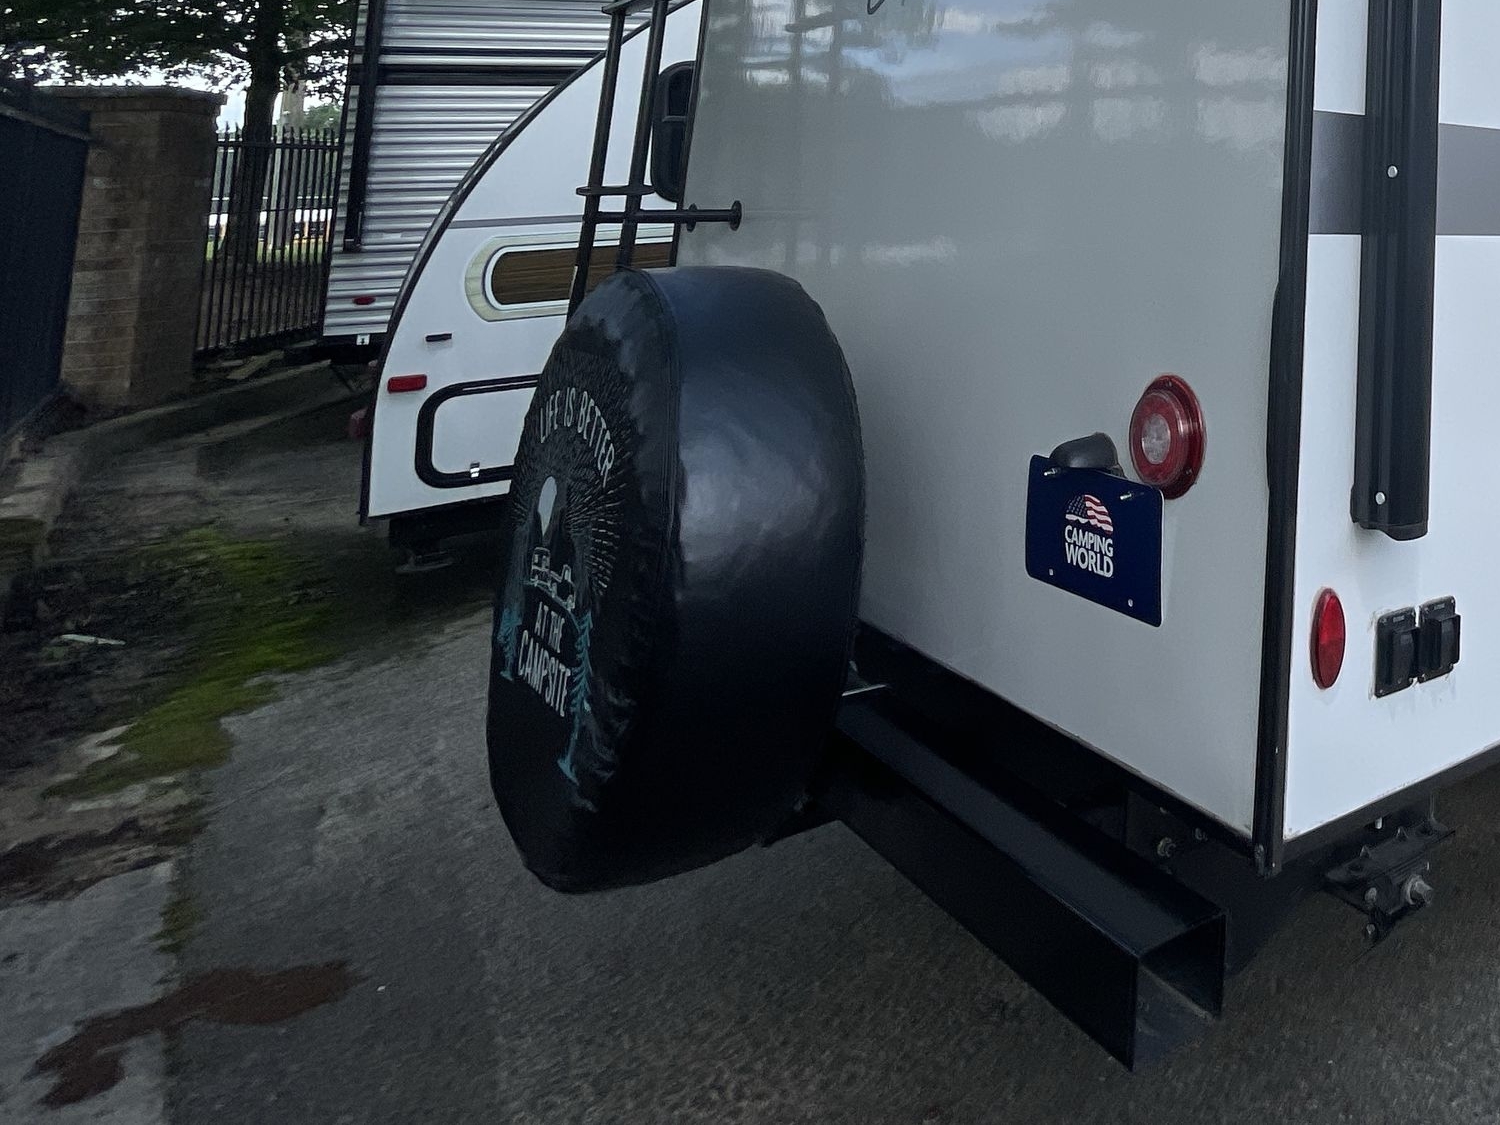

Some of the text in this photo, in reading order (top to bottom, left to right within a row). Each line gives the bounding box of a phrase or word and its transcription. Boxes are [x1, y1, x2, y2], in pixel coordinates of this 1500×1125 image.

[540, 386, 615, 488] LIFE IS BETTER
[1065, 525, 1113, 557] CAMPING
[1065, 542, 1113, 577] WORLD
[534, 601, 566, 653] AT THE
[518, 630, 571, 717] CAMPSITE
